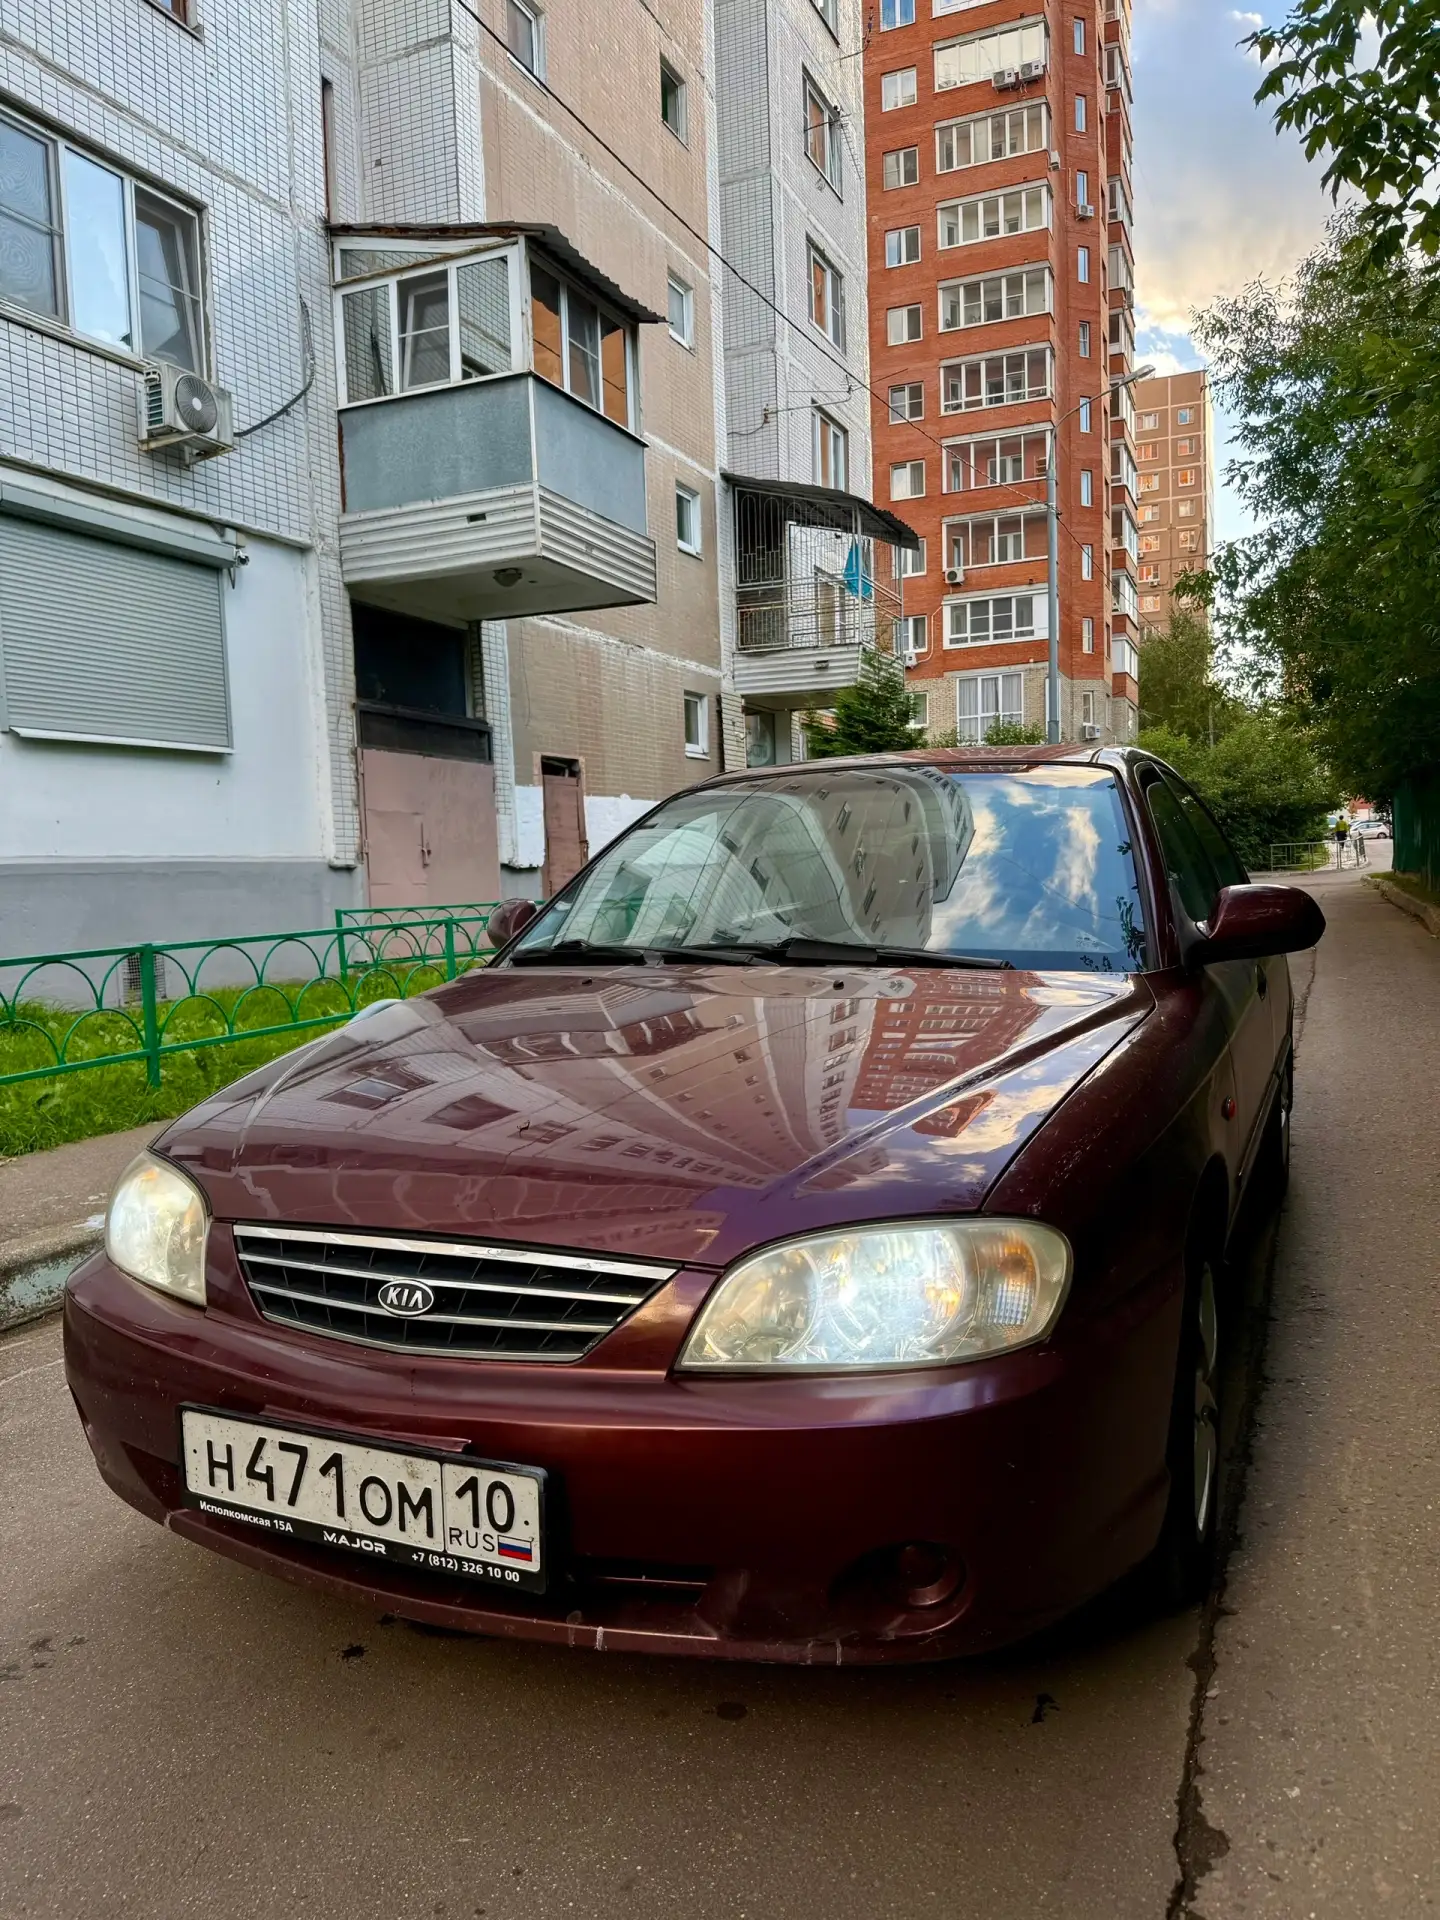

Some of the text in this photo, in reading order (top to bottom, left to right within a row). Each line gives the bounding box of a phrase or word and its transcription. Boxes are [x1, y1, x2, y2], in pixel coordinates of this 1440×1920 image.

[386, 1286, 423, 1309] KIA
[199, 1500, 294, 1533] Исполкомская 15А
[455, 1475, 515, 1534] 10
[322, 1530, 387, 1555] MAJOR
[448, 1526, 496, 1552] RUS
[411, 1552, 520, 1583] +7 (812) 326 10 00
